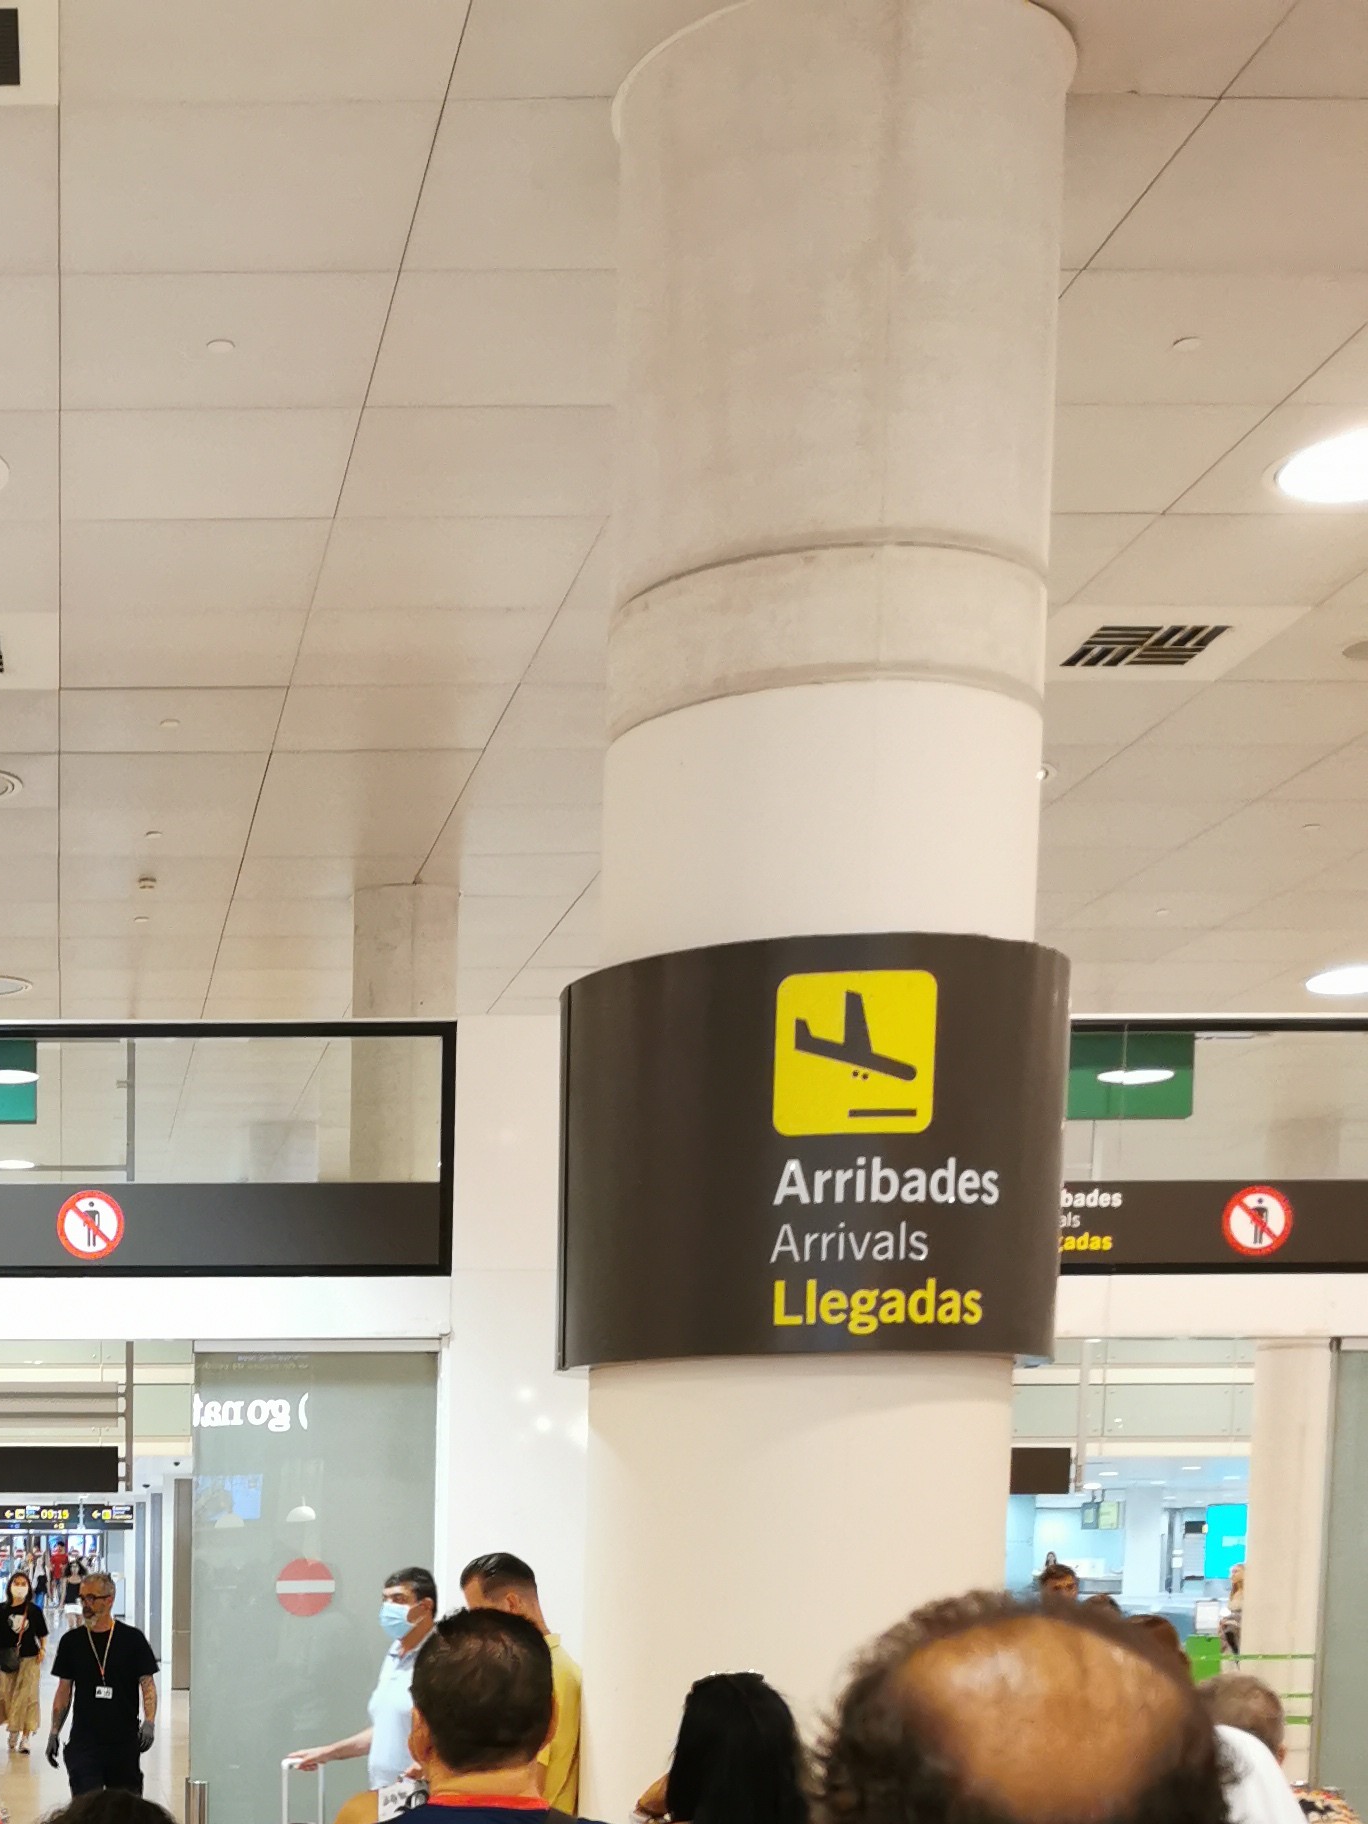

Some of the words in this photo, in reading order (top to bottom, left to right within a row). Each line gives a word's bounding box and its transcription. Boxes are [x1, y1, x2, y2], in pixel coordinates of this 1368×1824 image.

[773, 1156, 1000, 1205] Arribades
[770, 1221, 929, 1263] Arrivals
[773, 1277, 983, 1336] Llegadas
